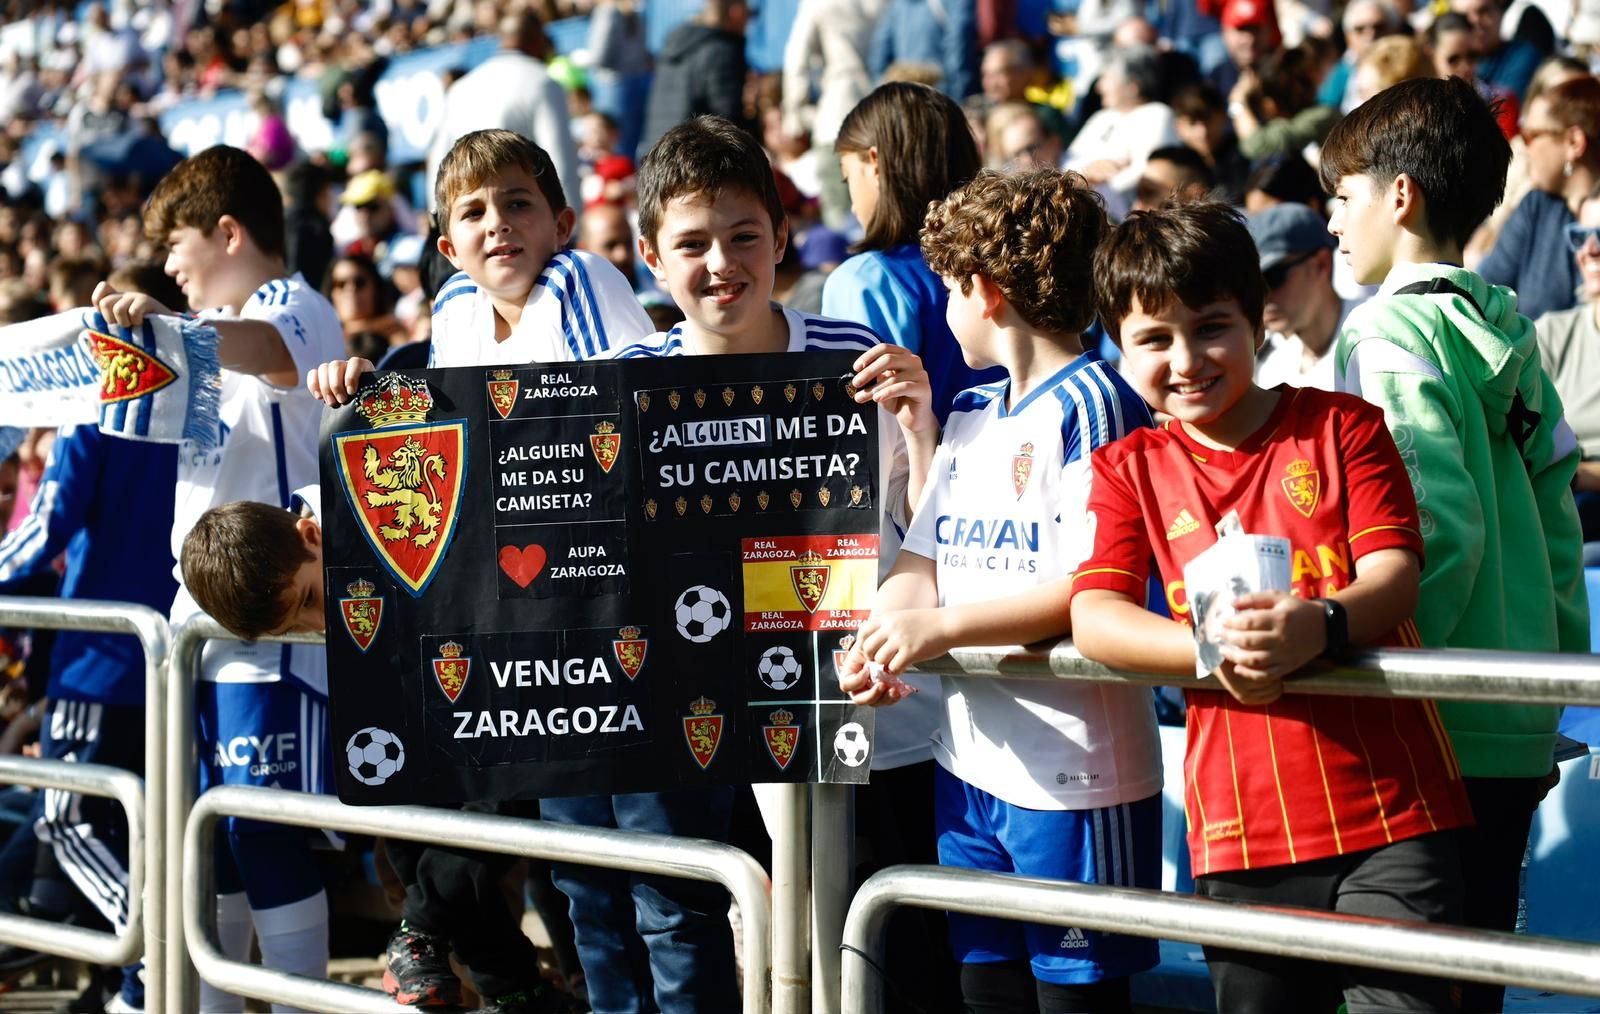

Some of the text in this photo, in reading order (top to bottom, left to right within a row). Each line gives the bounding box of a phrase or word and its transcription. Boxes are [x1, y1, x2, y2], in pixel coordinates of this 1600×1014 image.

[541, 373, 573, 385] REAL
[524, 385, 598, 400] ZARAGOZA
[648, 413, 868, 453] ¿ALGUIEN ME DA
[498, 443, 584, 465] ¿ALGUIEN
[501, 469, 584, 486] ME DA SU
[659, 453, 860, 488] SU CAMISETA?
[496, 493, 592, 512] CAMISETA?
[754, 541, 777, 549] REAL
[837, 538, 859, 547] REAL
[567, 546, 606, 558] AUPA
[743, 550, 797, 559] ZARAGOZA
[826, 548, 877, 557] ZARAGOZA
[550, 564, 625, 579] ZARAGOZA
[761, 611, 784, 620] REAL
[830, 609, 852, 618] REAL
[751, 620, 803, 630] ZARAGOZA
[489, 657, 612, 688] VENGA
[453, 704, 644, 739] ZARAGOZA
[213, 732, 296, 767] ACYF
[249, 761, 296, 776] GROUP
[1060, 939, 1089, 949] adidas
